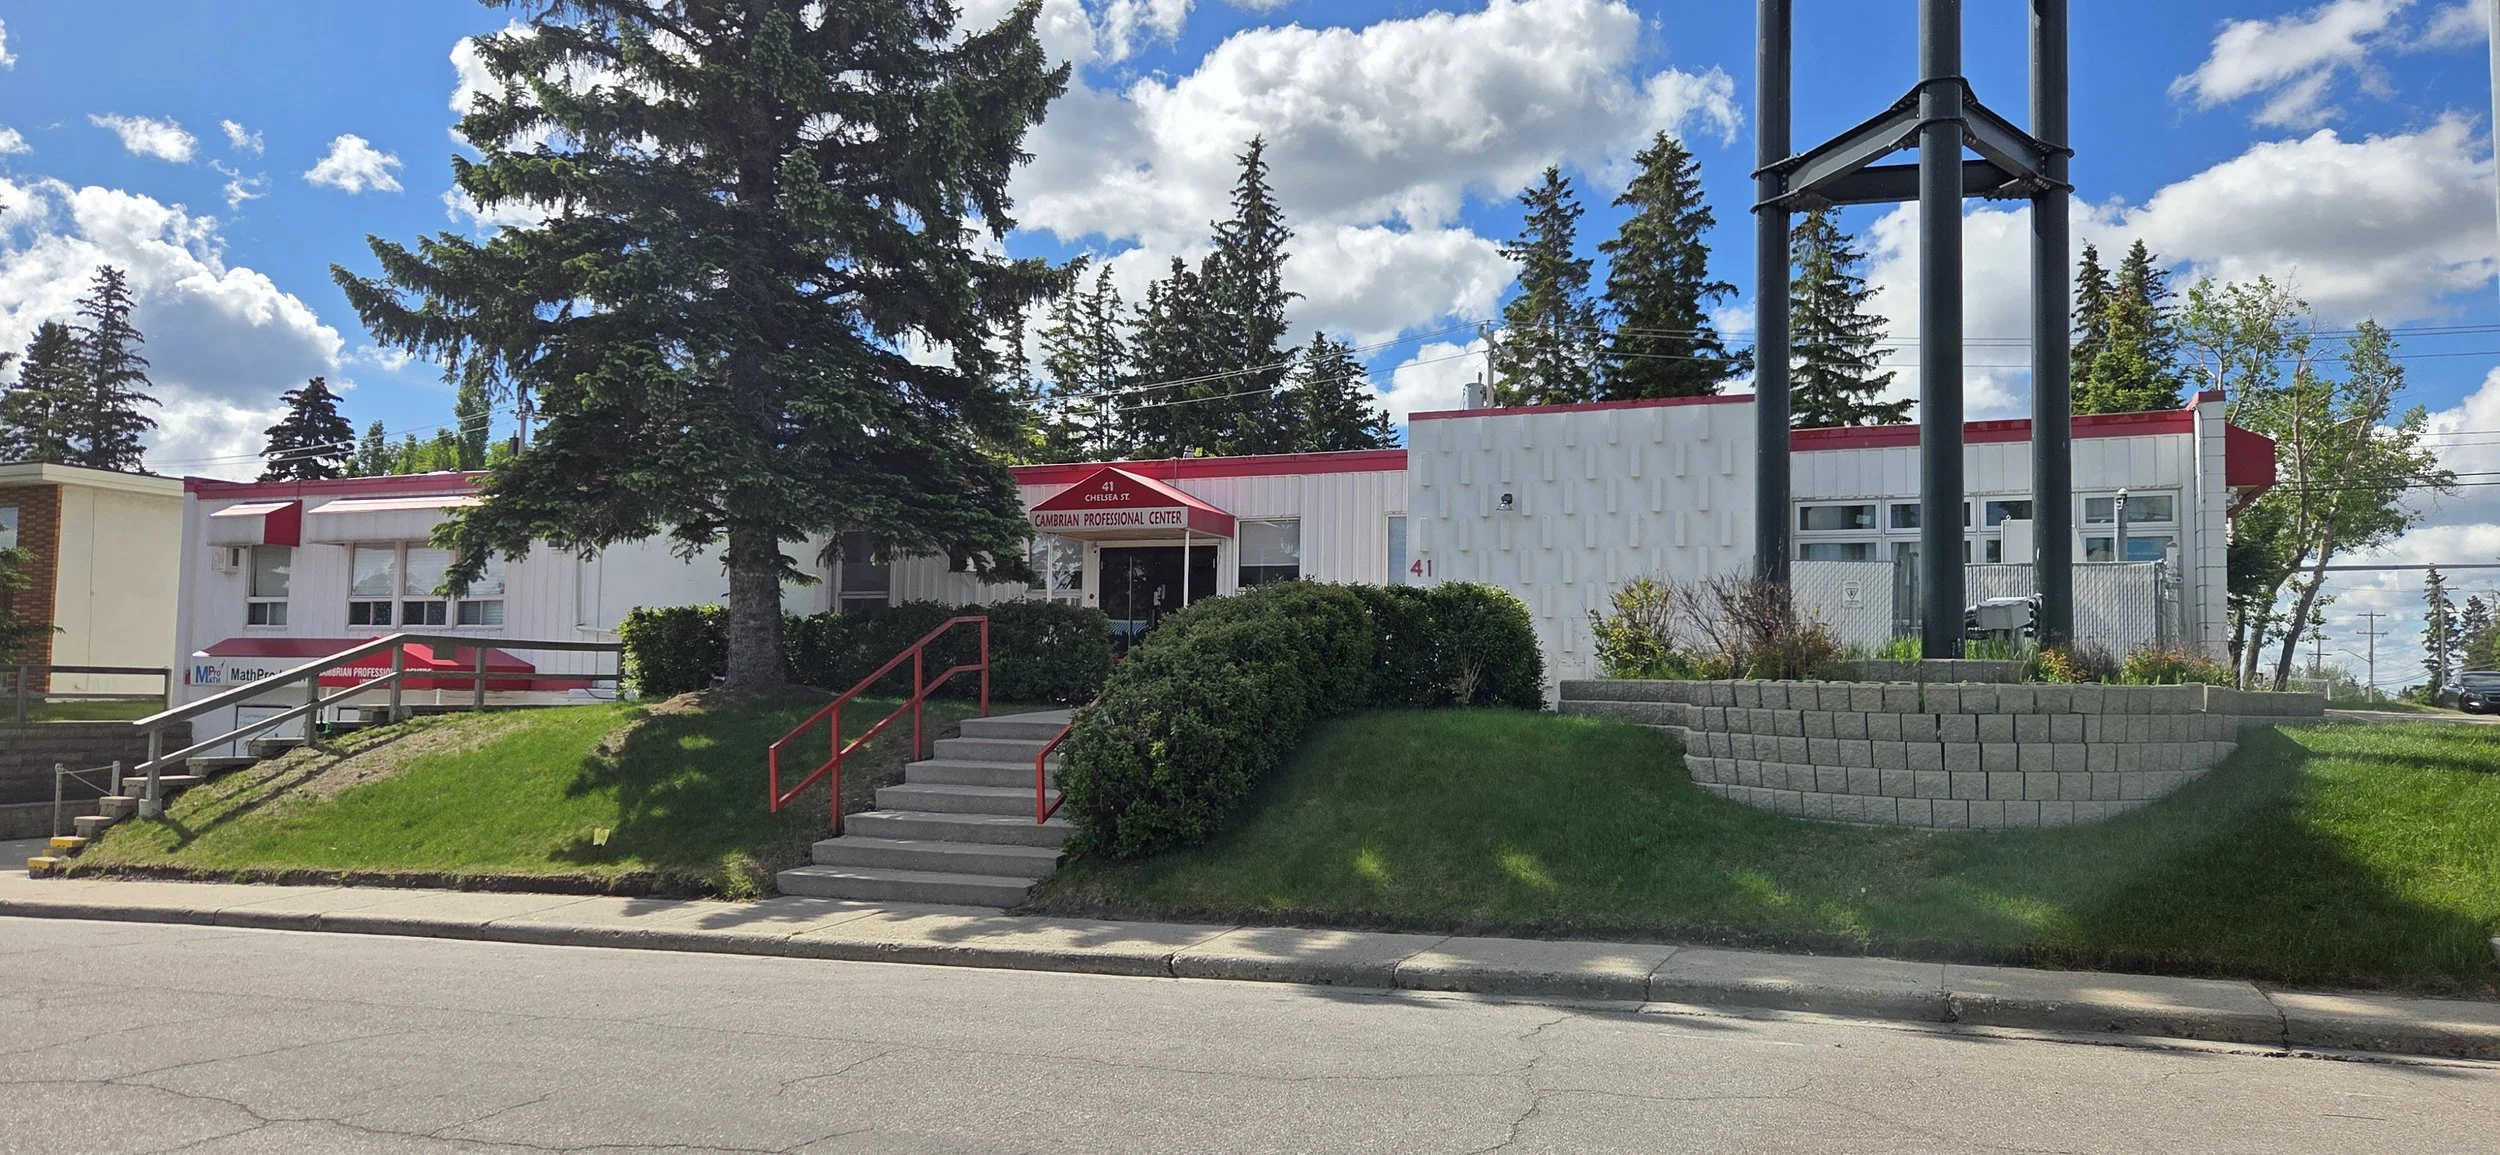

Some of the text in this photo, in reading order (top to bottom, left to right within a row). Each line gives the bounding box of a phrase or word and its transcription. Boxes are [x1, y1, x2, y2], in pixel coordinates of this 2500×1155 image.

[1101, 481, 1114, 492] 41
[1084, 493, 1118, 502] CHELSEA
[1034, 510, 1182, 528] CAMBRIAN PROFESSIONAL CENTER
[1410, 559, 1432, 577] 41
[353, 666, 393, 677] PROFESSIO
